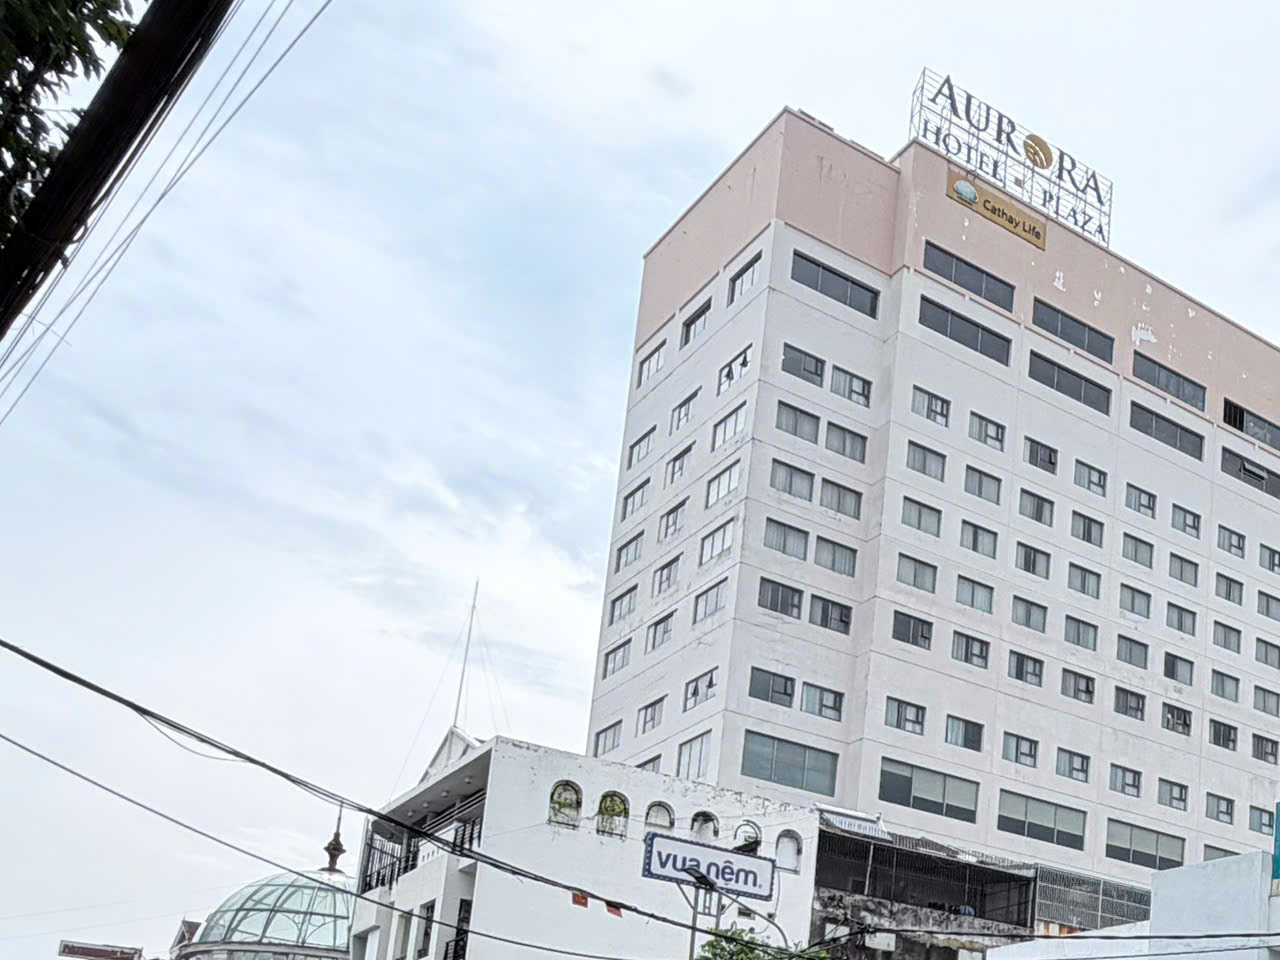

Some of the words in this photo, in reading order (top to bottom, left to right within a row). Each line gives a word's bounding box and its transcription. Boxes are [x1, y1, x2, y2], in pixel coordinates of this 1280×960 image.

[921, 118, 1004, 182] HOTEL
[1041, 189, 1107, 242] PLAZA
[928, 74, 1106, 206] AURORA
[983, 199, 1021, 229] Cathay
[1022, 221, 1042, 240] Life
